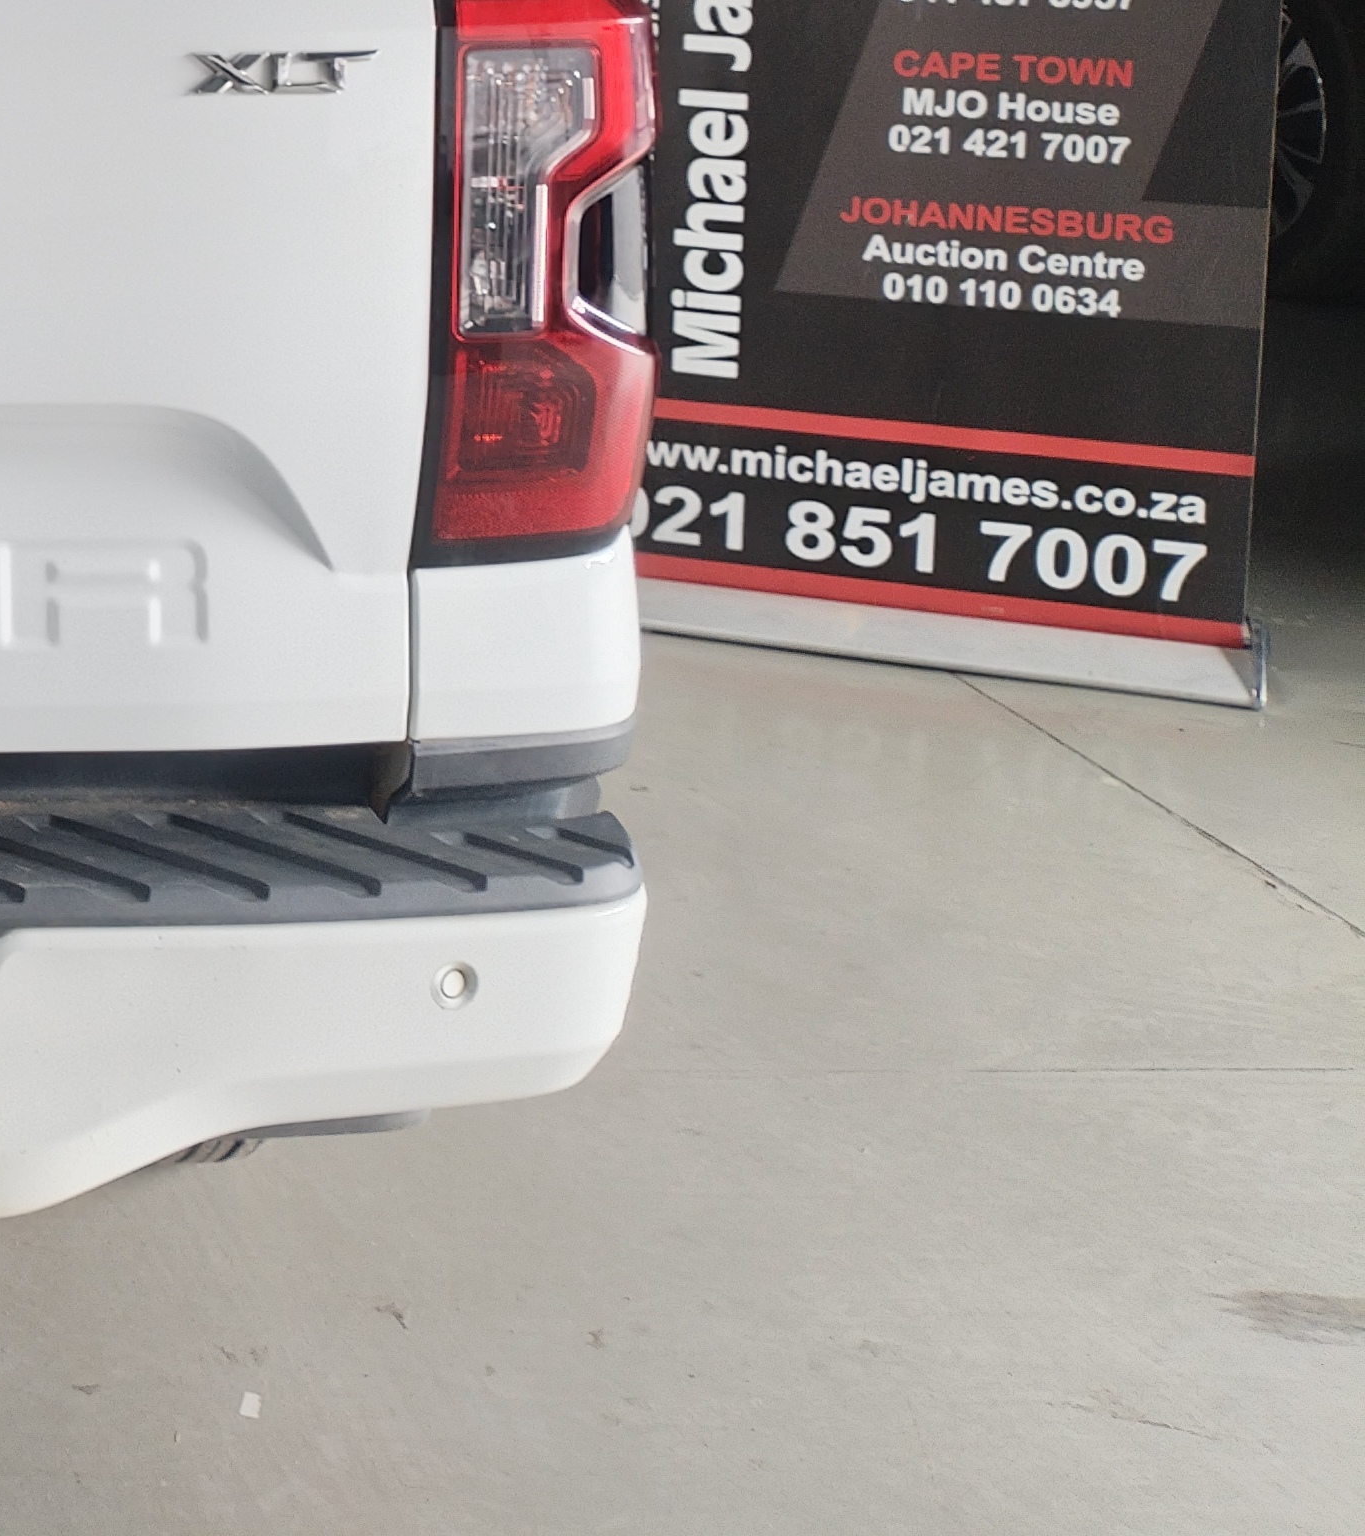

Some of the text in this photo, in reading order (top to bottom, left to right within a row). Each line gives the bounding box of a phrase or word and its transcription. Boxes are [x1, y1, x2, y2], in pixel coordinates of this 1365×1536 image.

[185, 49, 379, 95] XLT
[894, 50, 1133, 87] CAPE TOWN
[903, 88, 1120, 126] MJO House
[889, 124, 1131, 164] 021 421 7007
[671, 89, 748, 378] Michael
[841, 197, 1173, 244] JOHANNESBURG
[862, 234, 1145, 281] Auction Centre
[883, 273, 1121, 317] 010 110 0634
[786, 501, 935, 573] 851
[980, 521, 1207, 601] 7007
